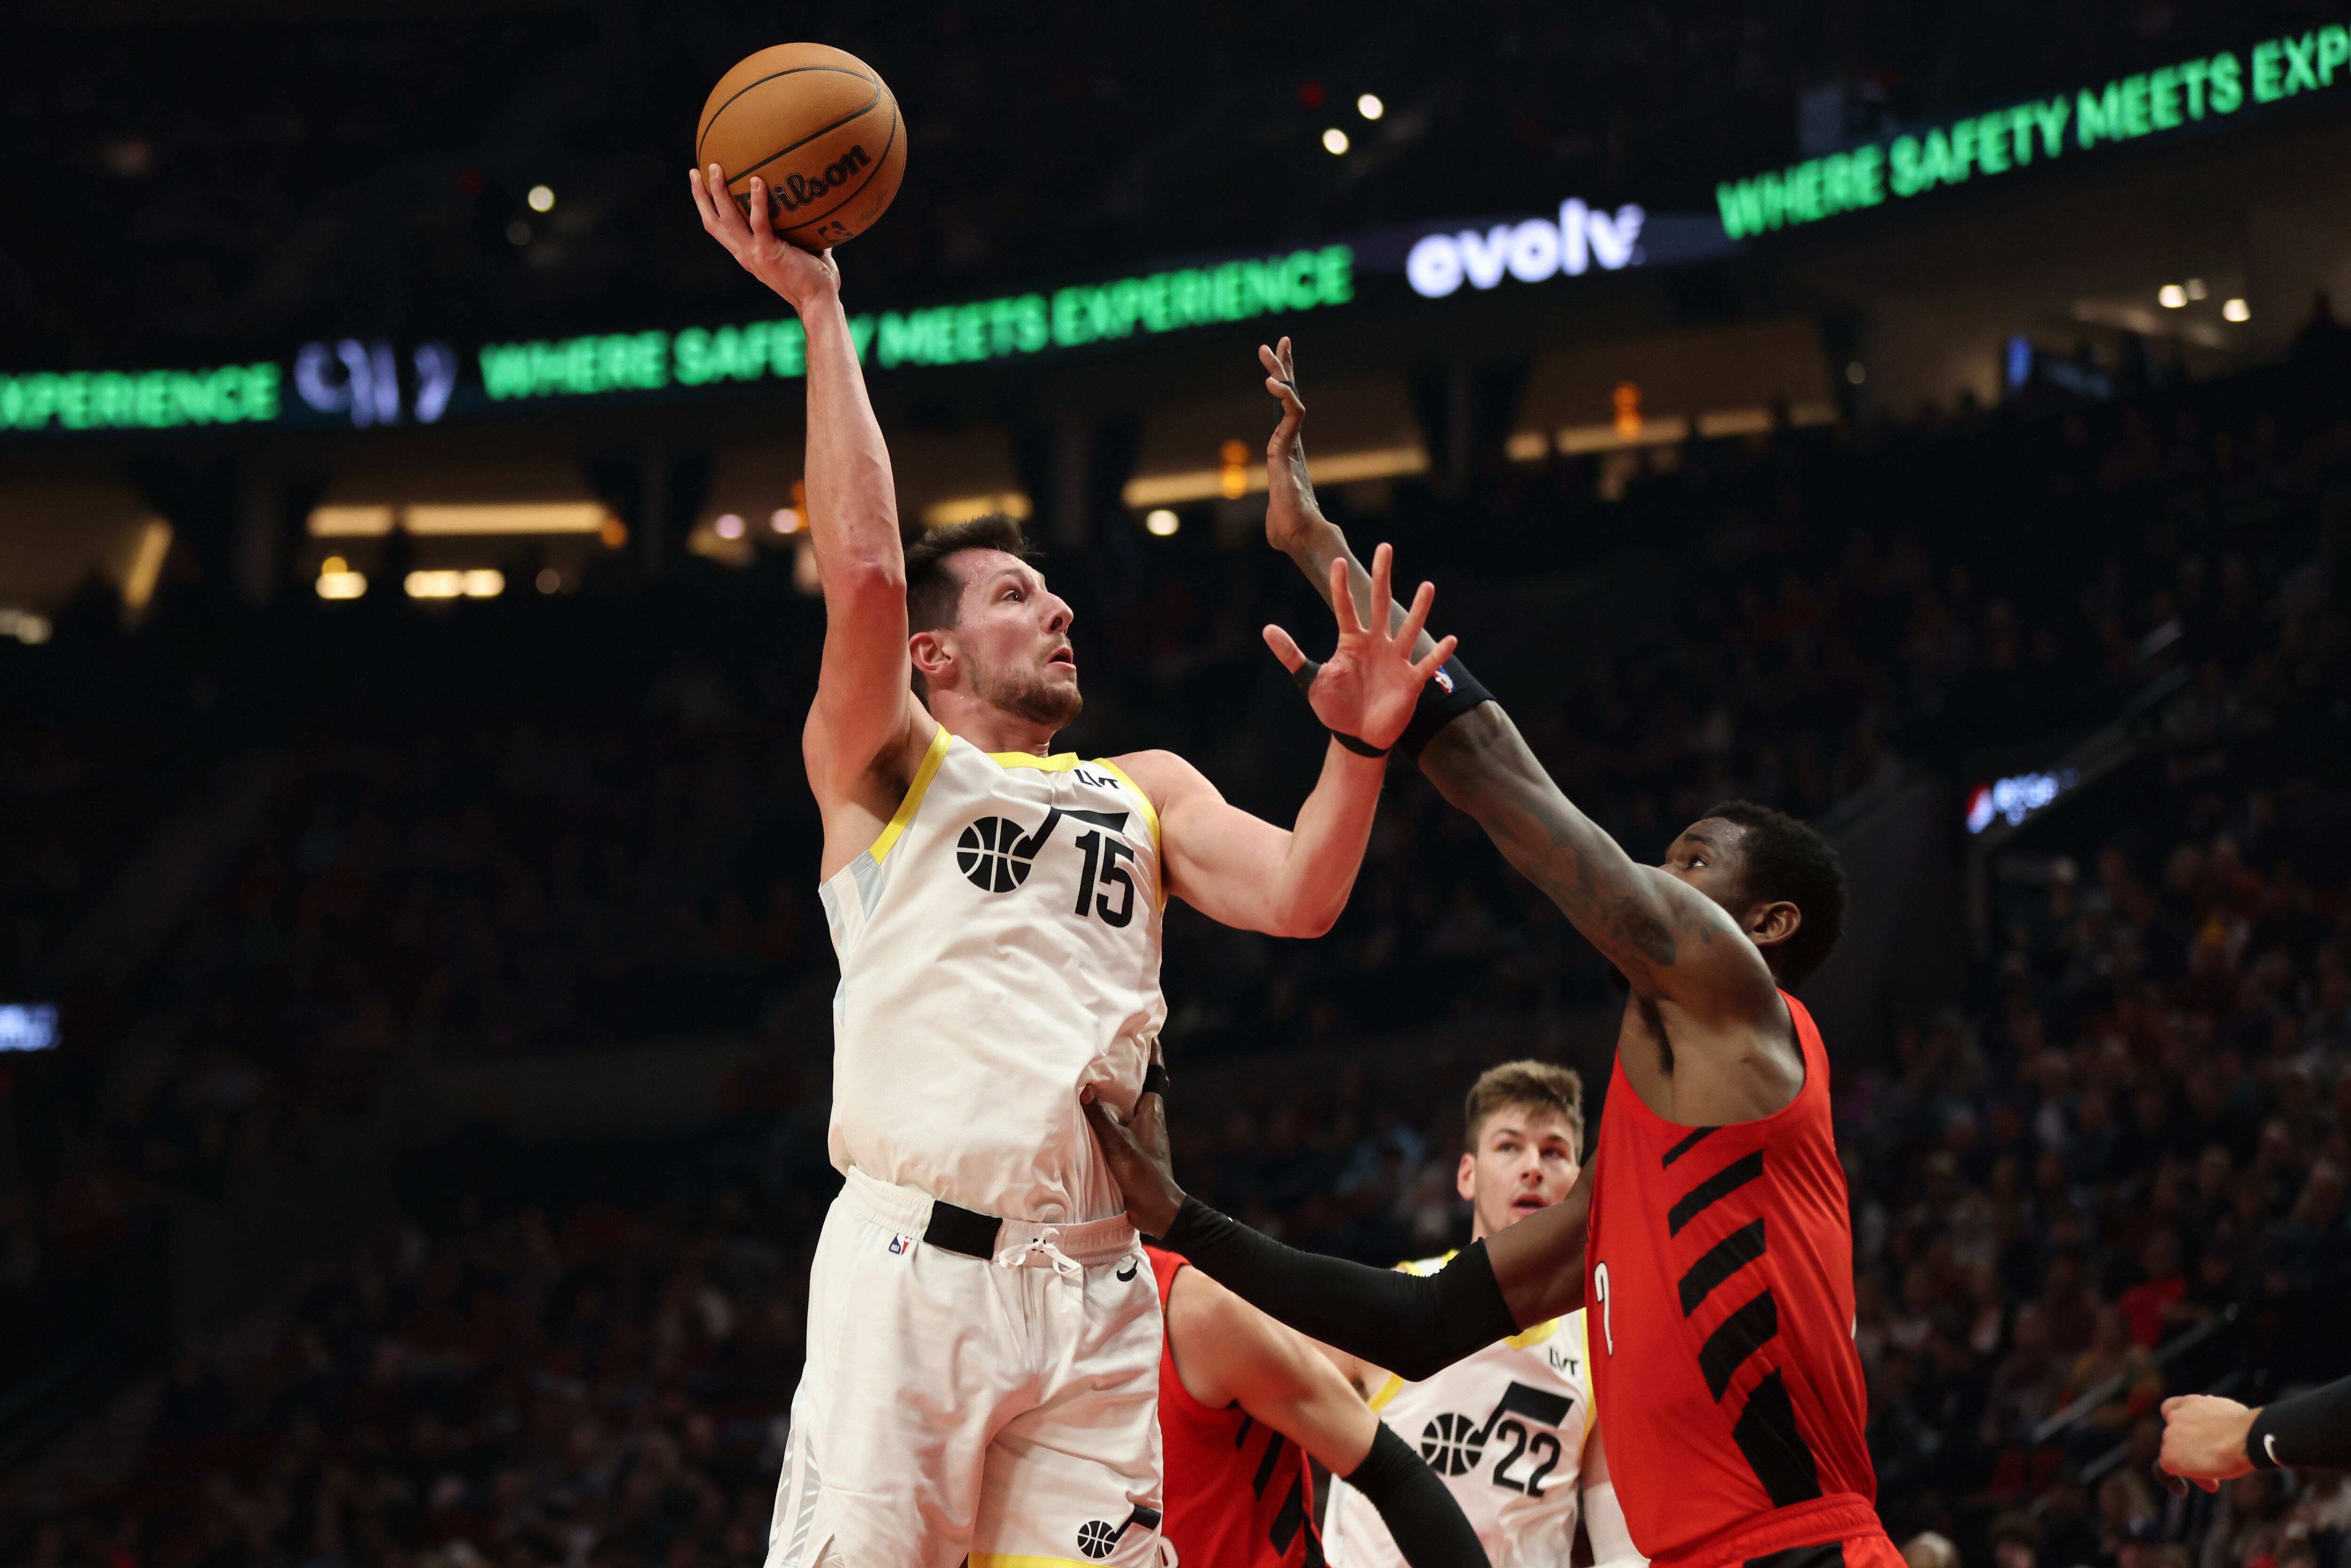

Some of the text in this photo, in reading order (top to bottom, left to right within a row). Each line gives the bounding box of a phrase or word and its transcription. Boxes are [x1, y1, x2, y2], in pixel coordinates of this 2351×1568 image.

[1716, 143, 1885, 240] WHERE
[1889, 95, 2071, 197] SAFETY
[2076, 51, 2243, 149] MEETS
[1405, 197, 1646, 299] evolv
[479, 329, 670, 401] WHERE
[672, 314, 876, 386] SAFEY
[876, 292, 1050, 369] MEETS
[1051, 244, 1354, 347] EXPERIENCE
[1074, 829, 1134, 928] 15
[890, 1244, 900, 1253] NBA
[1492, 1419, 1561, 1497] 22
